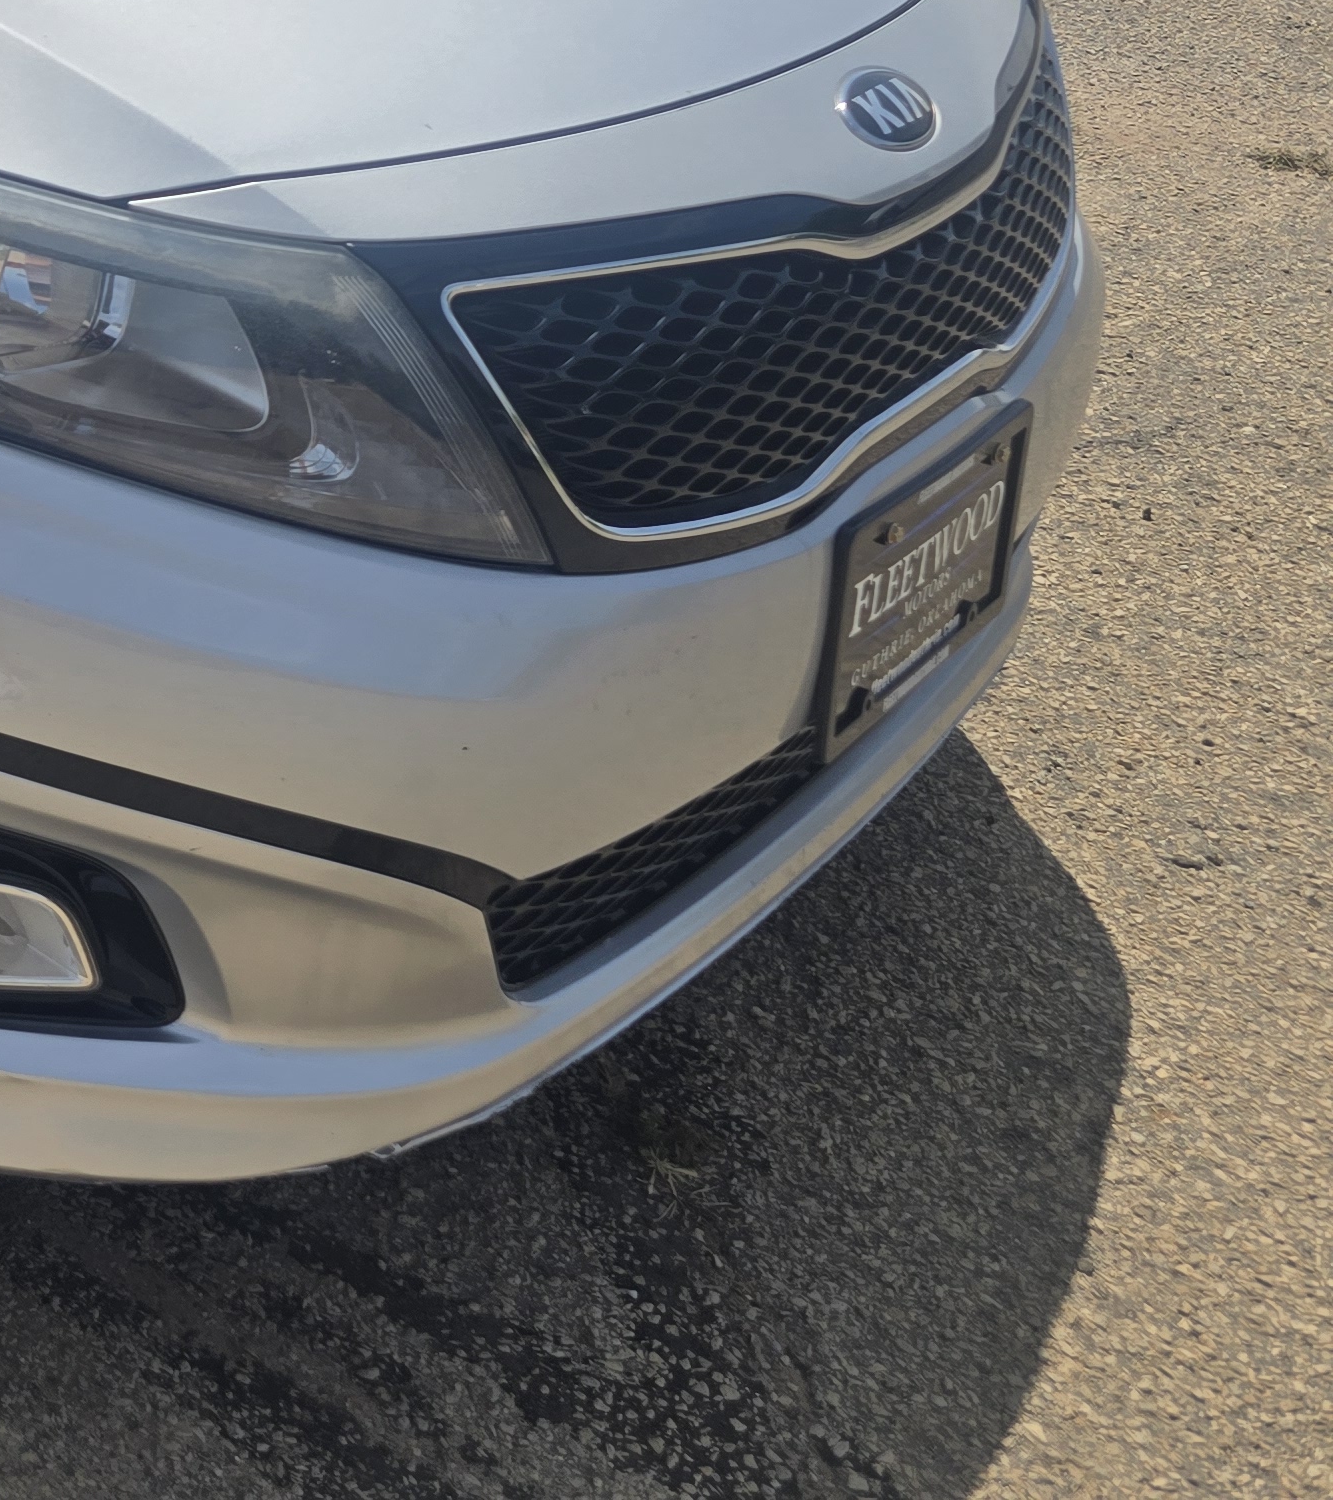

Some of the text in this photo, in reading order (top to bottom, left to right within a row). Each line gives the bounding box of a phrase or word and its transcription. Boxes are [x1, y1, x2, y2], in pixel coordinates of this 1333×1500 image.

[851, 77, 931, 135] KIA
[849, 480, 1006, 638] FLEETWOOD
[903, 567, 952, 620] MOTORS
[917, 569, 983, 633] OKLAHOMA
